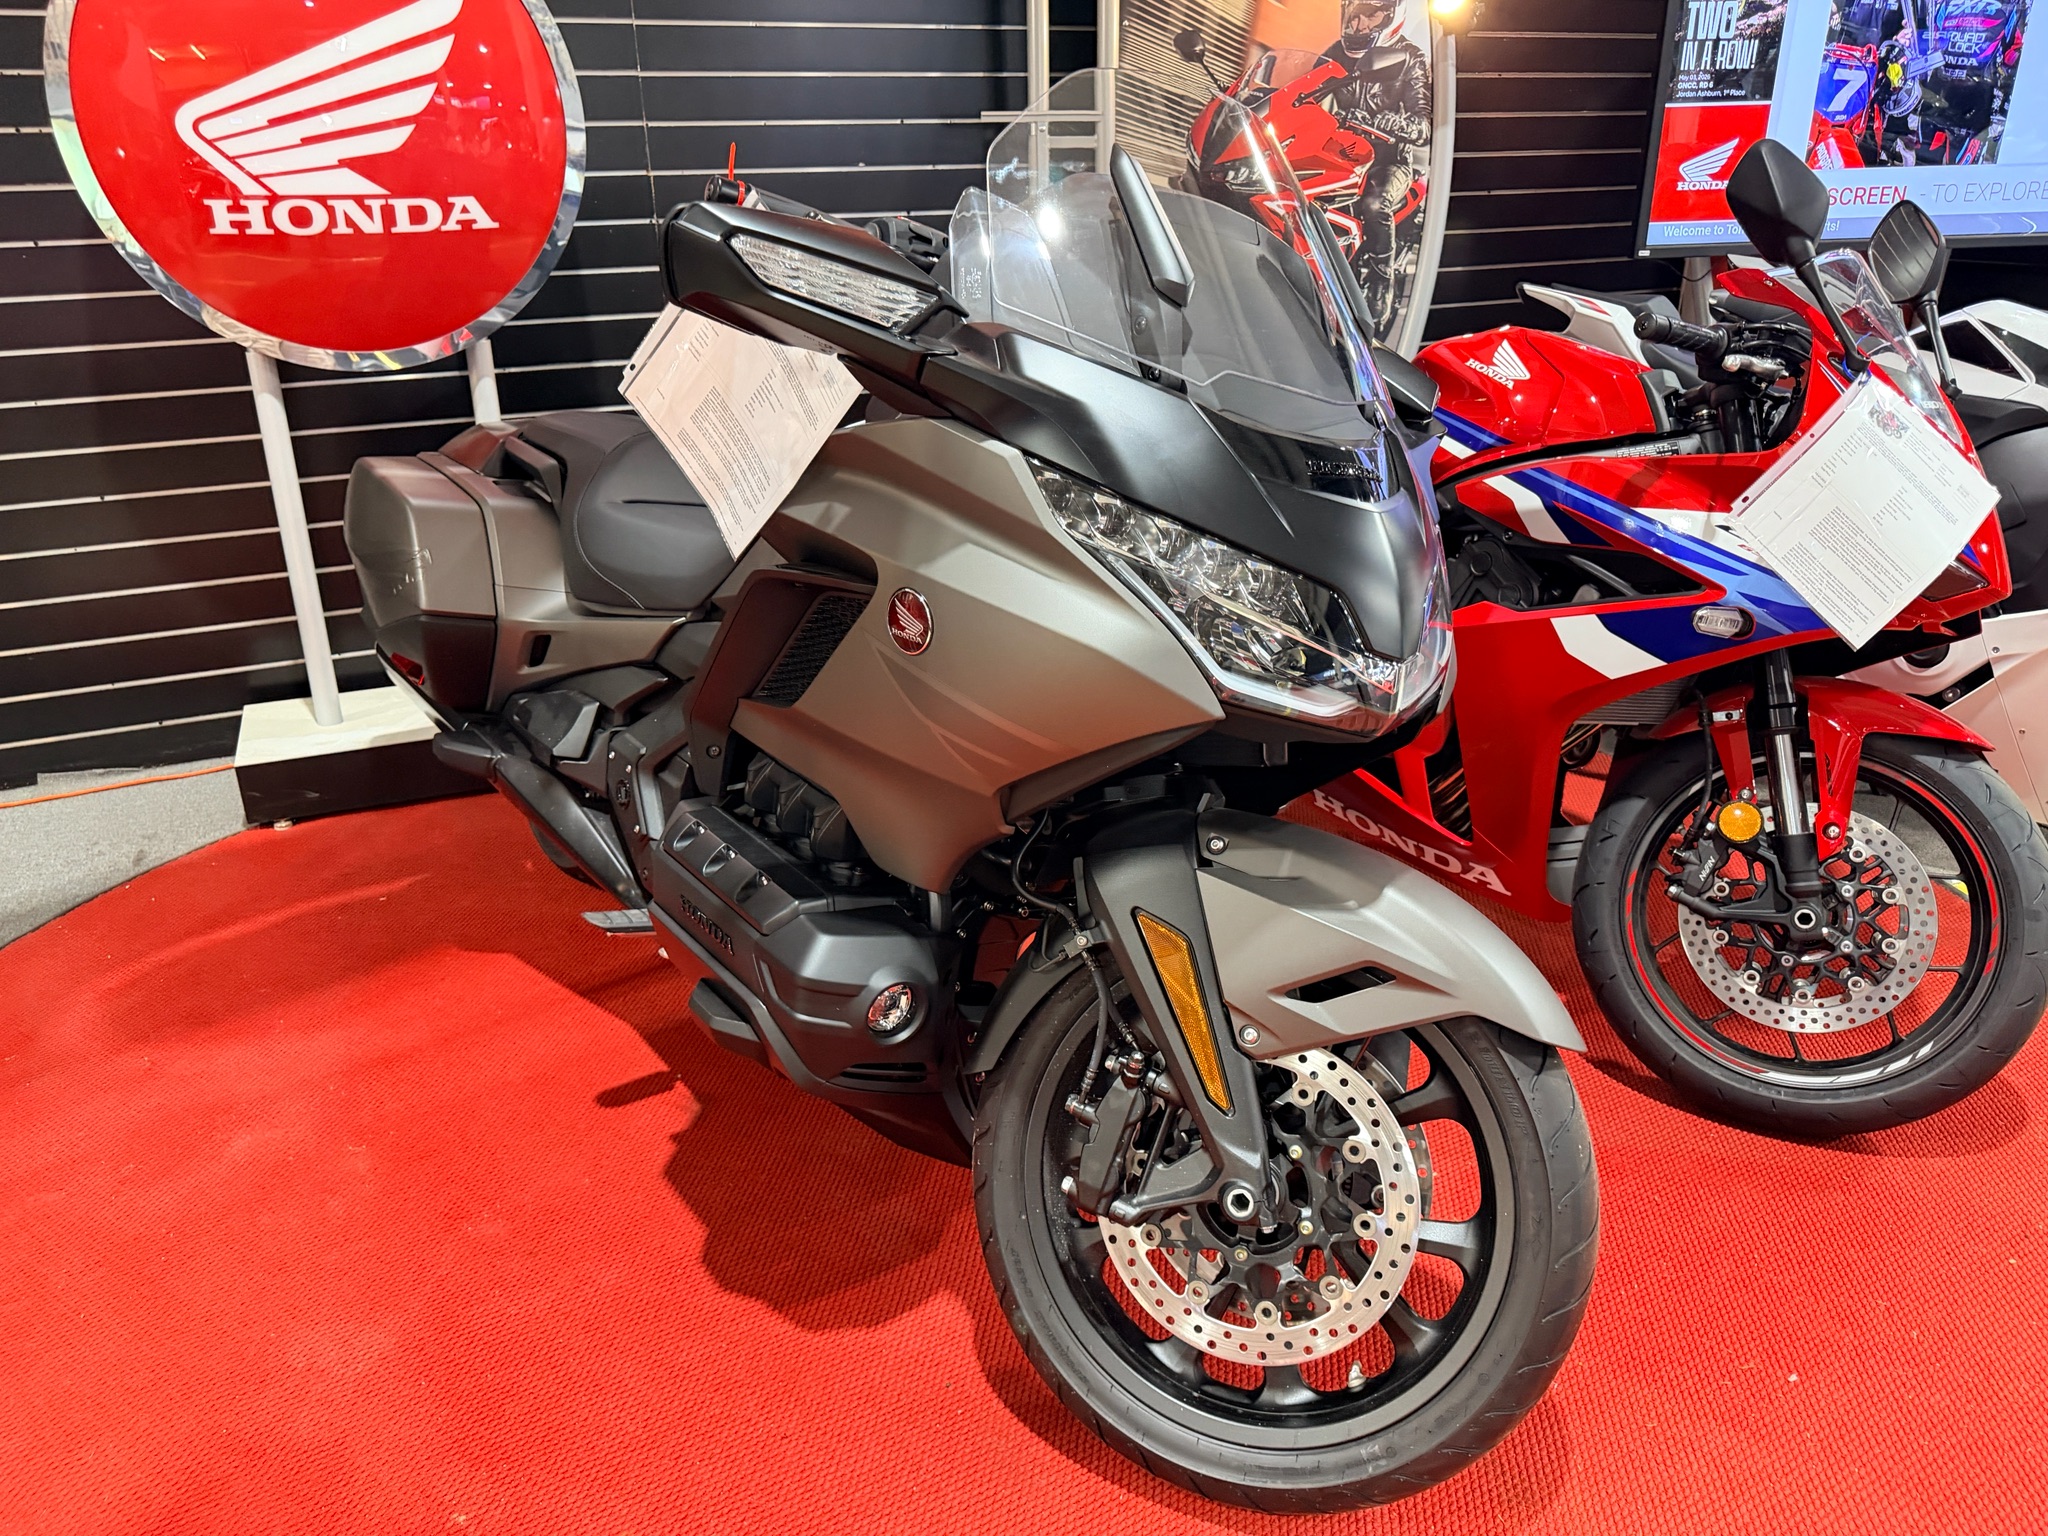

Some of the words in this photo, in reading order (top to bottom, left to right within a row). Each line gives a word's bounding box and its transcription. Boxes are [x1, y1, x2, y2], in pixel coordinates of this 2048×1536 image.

[1686, 1, 1738, 40] TWO
[1948, 42, 1981, 54] LOCK
[1950, 32, 1986, 43] QUAD
[1680, 41, 1698, 71] IN
[1700, 40, 1713, 70] A
[1716, 39, 1759, 69] ROW!
[1676, 90, 1696, 98] Jordan
[1827, 68, 1868, 112] 7
[1829, 186, 1907, 206] SCREEN
[1932, 183, 1959, 203] TO
[202, 195, 500, 236] HONDA
[1664, 225, 1711, 237] Welcome
[1714, 225, 1724, 235] to
[1465, 358, 1515, 390] HONDA
[891, 627, 923, 645] HONDA
[1313, 789, 1512, 896] HONDA
